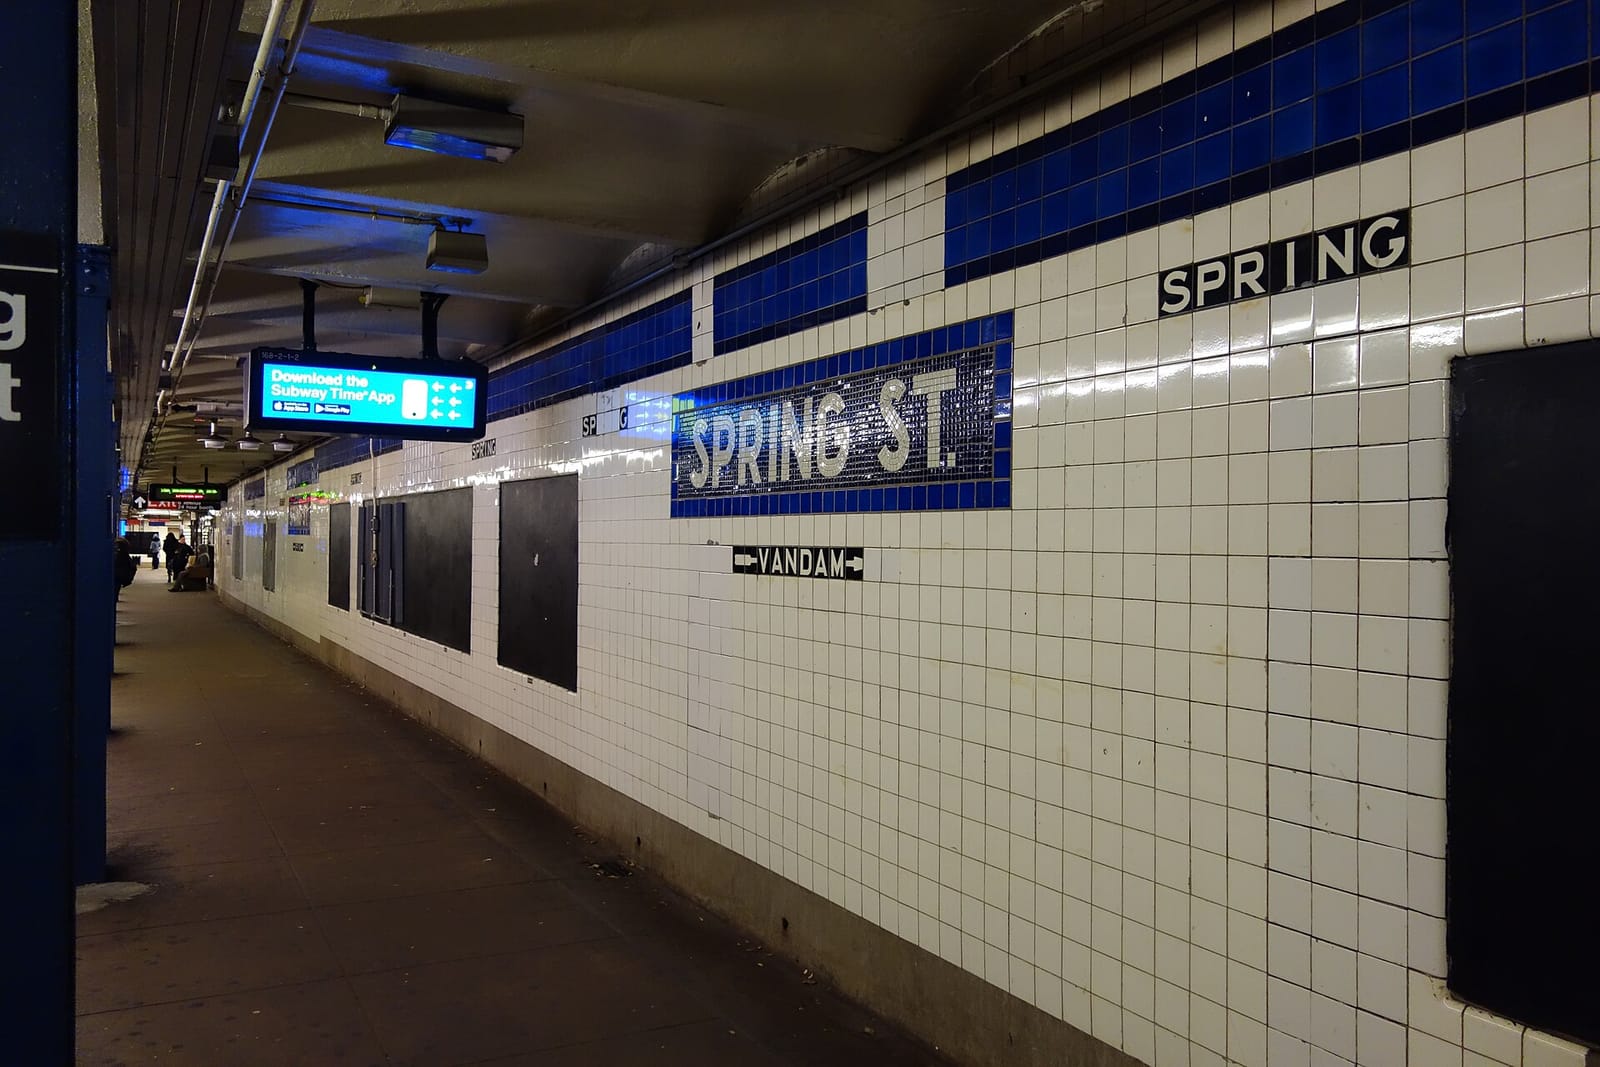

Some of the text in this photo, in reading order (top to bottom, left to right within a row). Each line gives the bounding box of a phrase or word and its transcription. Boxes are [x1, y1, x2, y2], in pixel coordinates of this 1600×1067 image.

[1160, 216, 1406, 313] SPRING
[271, 369, 368, 388] Download the
[271, 383, 328, 402] Subway
[368, 390, 395, 405] App
[690, 368, 957, 489] SPRING ST.
[758, 547, 844, 578] VANDAM
